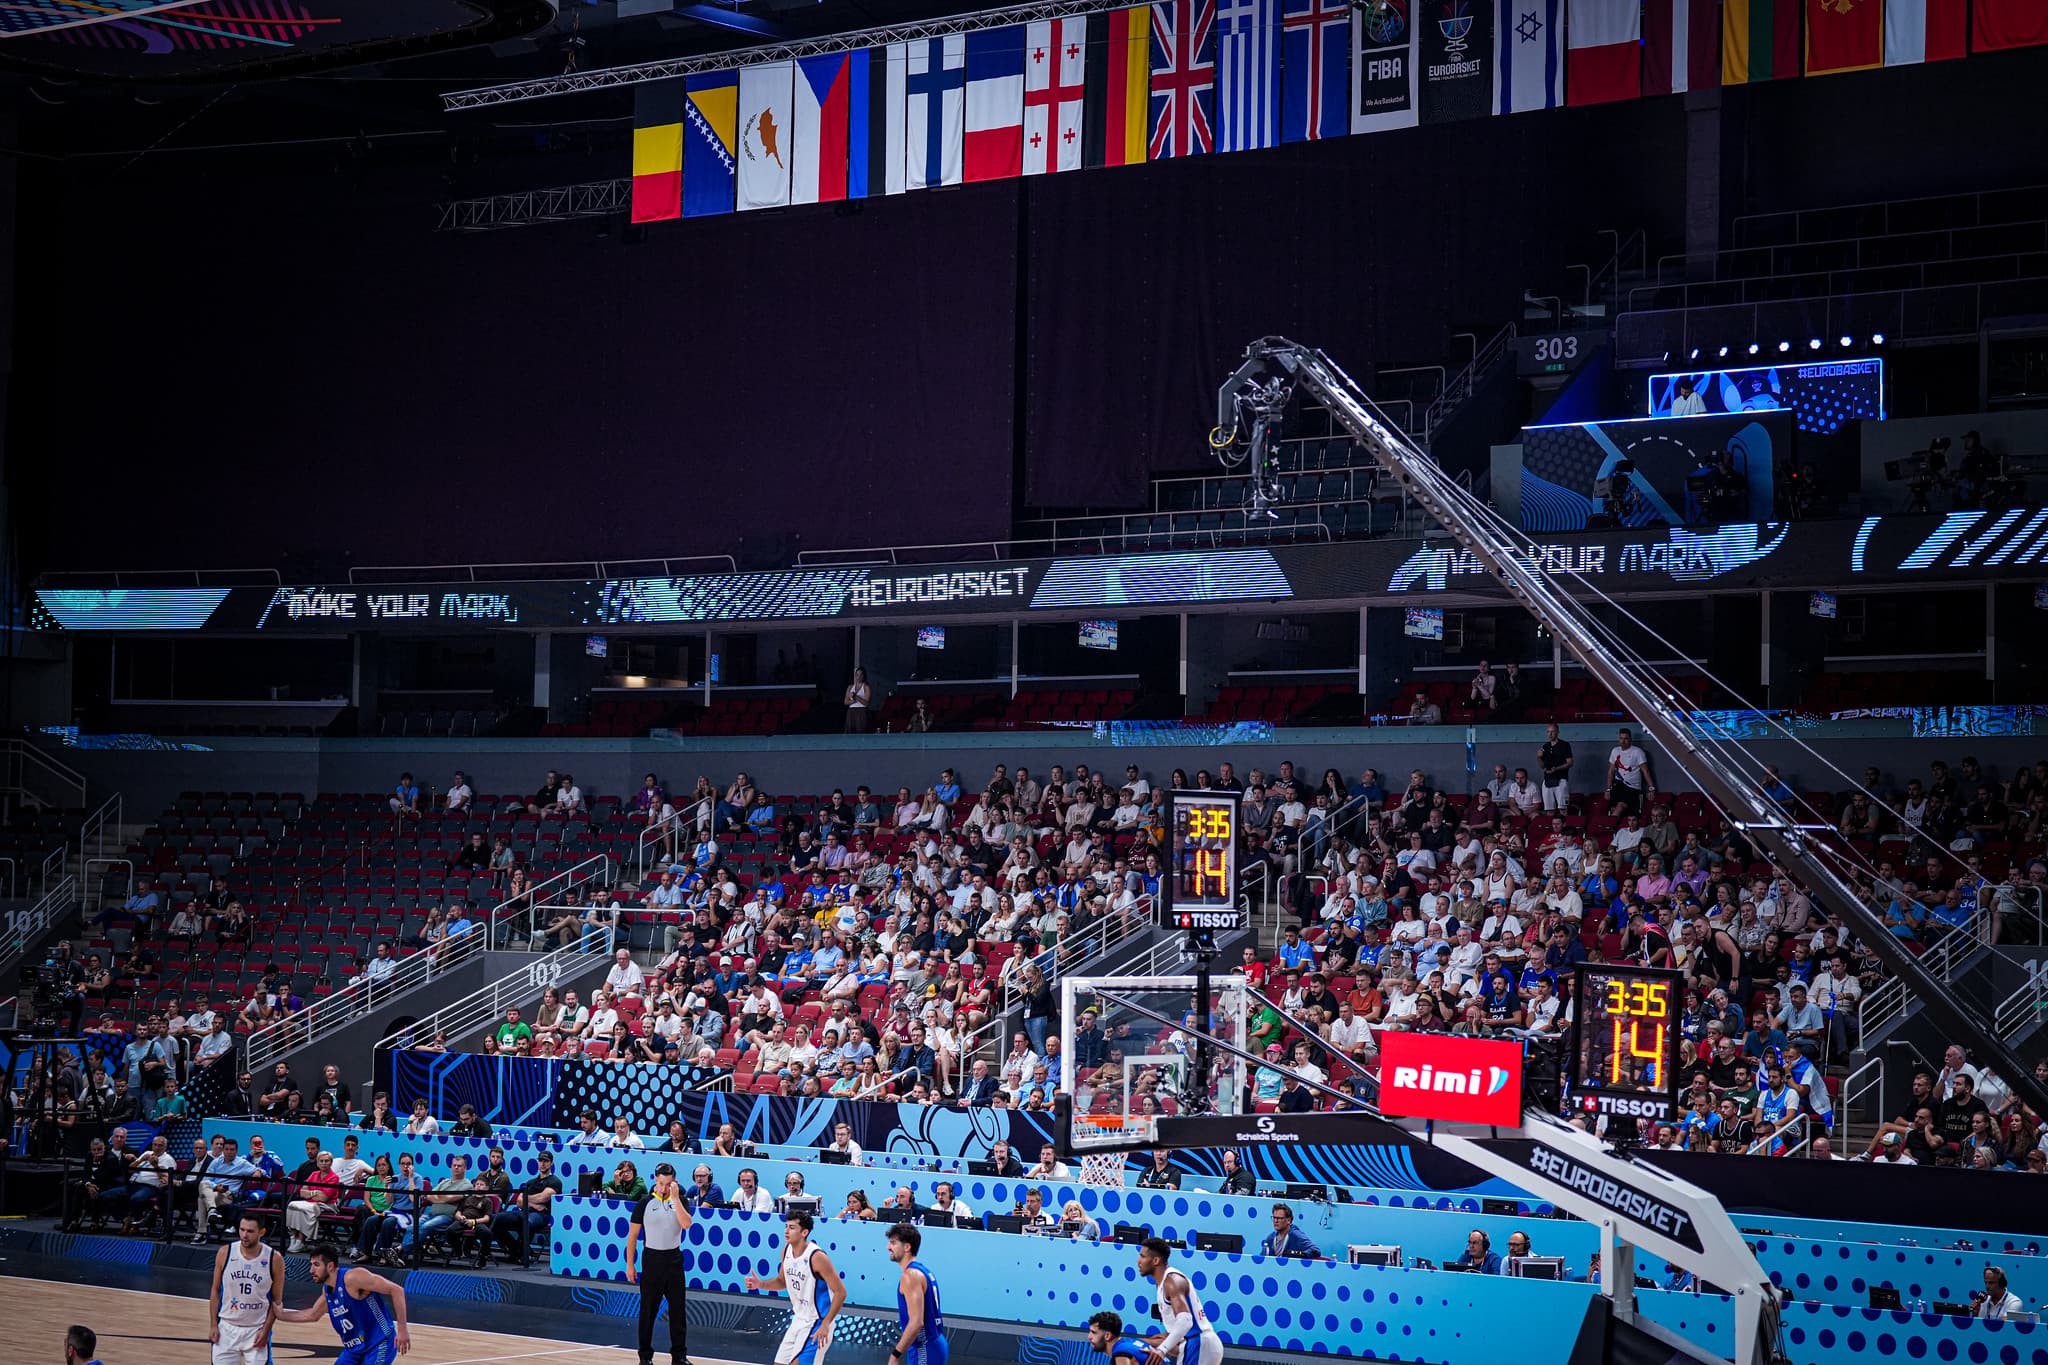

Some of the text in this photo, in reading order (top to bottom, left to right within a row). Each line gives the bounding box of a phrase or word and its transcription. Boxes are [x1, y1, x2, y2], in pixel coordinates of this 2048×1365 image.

[1368, 57, 1402, 81] FIBA
[1428, 59, 1481, 77] EUROBASKET
[1534, 336, 1578, 361] 303
[1798, 361, 1880, 379] #EUROBASKET
[849, 567, 1029, 607] #EUROBASKET
[288, 593, 511, 618] MAKE YOUR MARK
[1188, 808, 1231, 839] 3:35
[1194, 849, 1227, 896] 14
[1191, 913, 1239, 928] TISSOT
[1606, 980, 1668, 1018] 3:35
[1611, 1019, 1664, 1088] 14
[1393, 1064, 1482, 1096] Rimi
[1598, 1096, 1669, 1118] TISSOT
[1236, 1132, 1299, 1142] Schelde Sports
[1530, 1146, 1688, 1237] #EUROBASKET
[230, 1269, 263, 1284] HELLAS
[239, 1282, 252, 1295] 16
